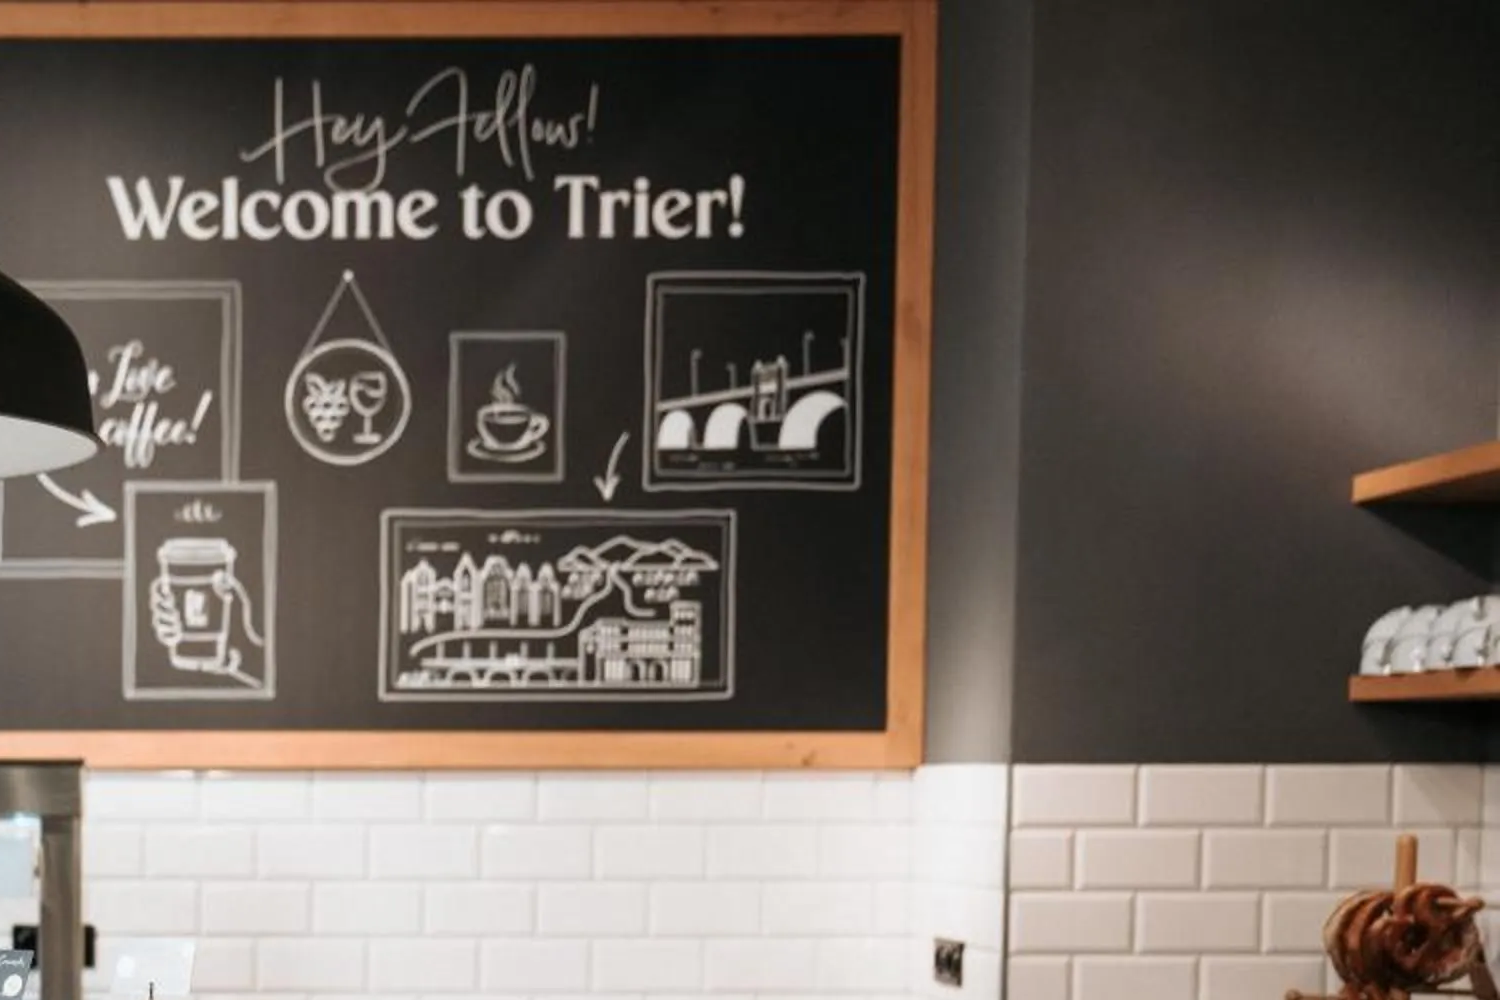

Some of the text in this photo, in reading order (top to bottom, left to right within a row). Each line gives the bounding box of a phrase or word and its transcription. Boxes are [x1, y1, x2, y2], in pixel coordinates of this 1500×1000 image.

[107, 174, 746, 240] Welcome to Trier!
